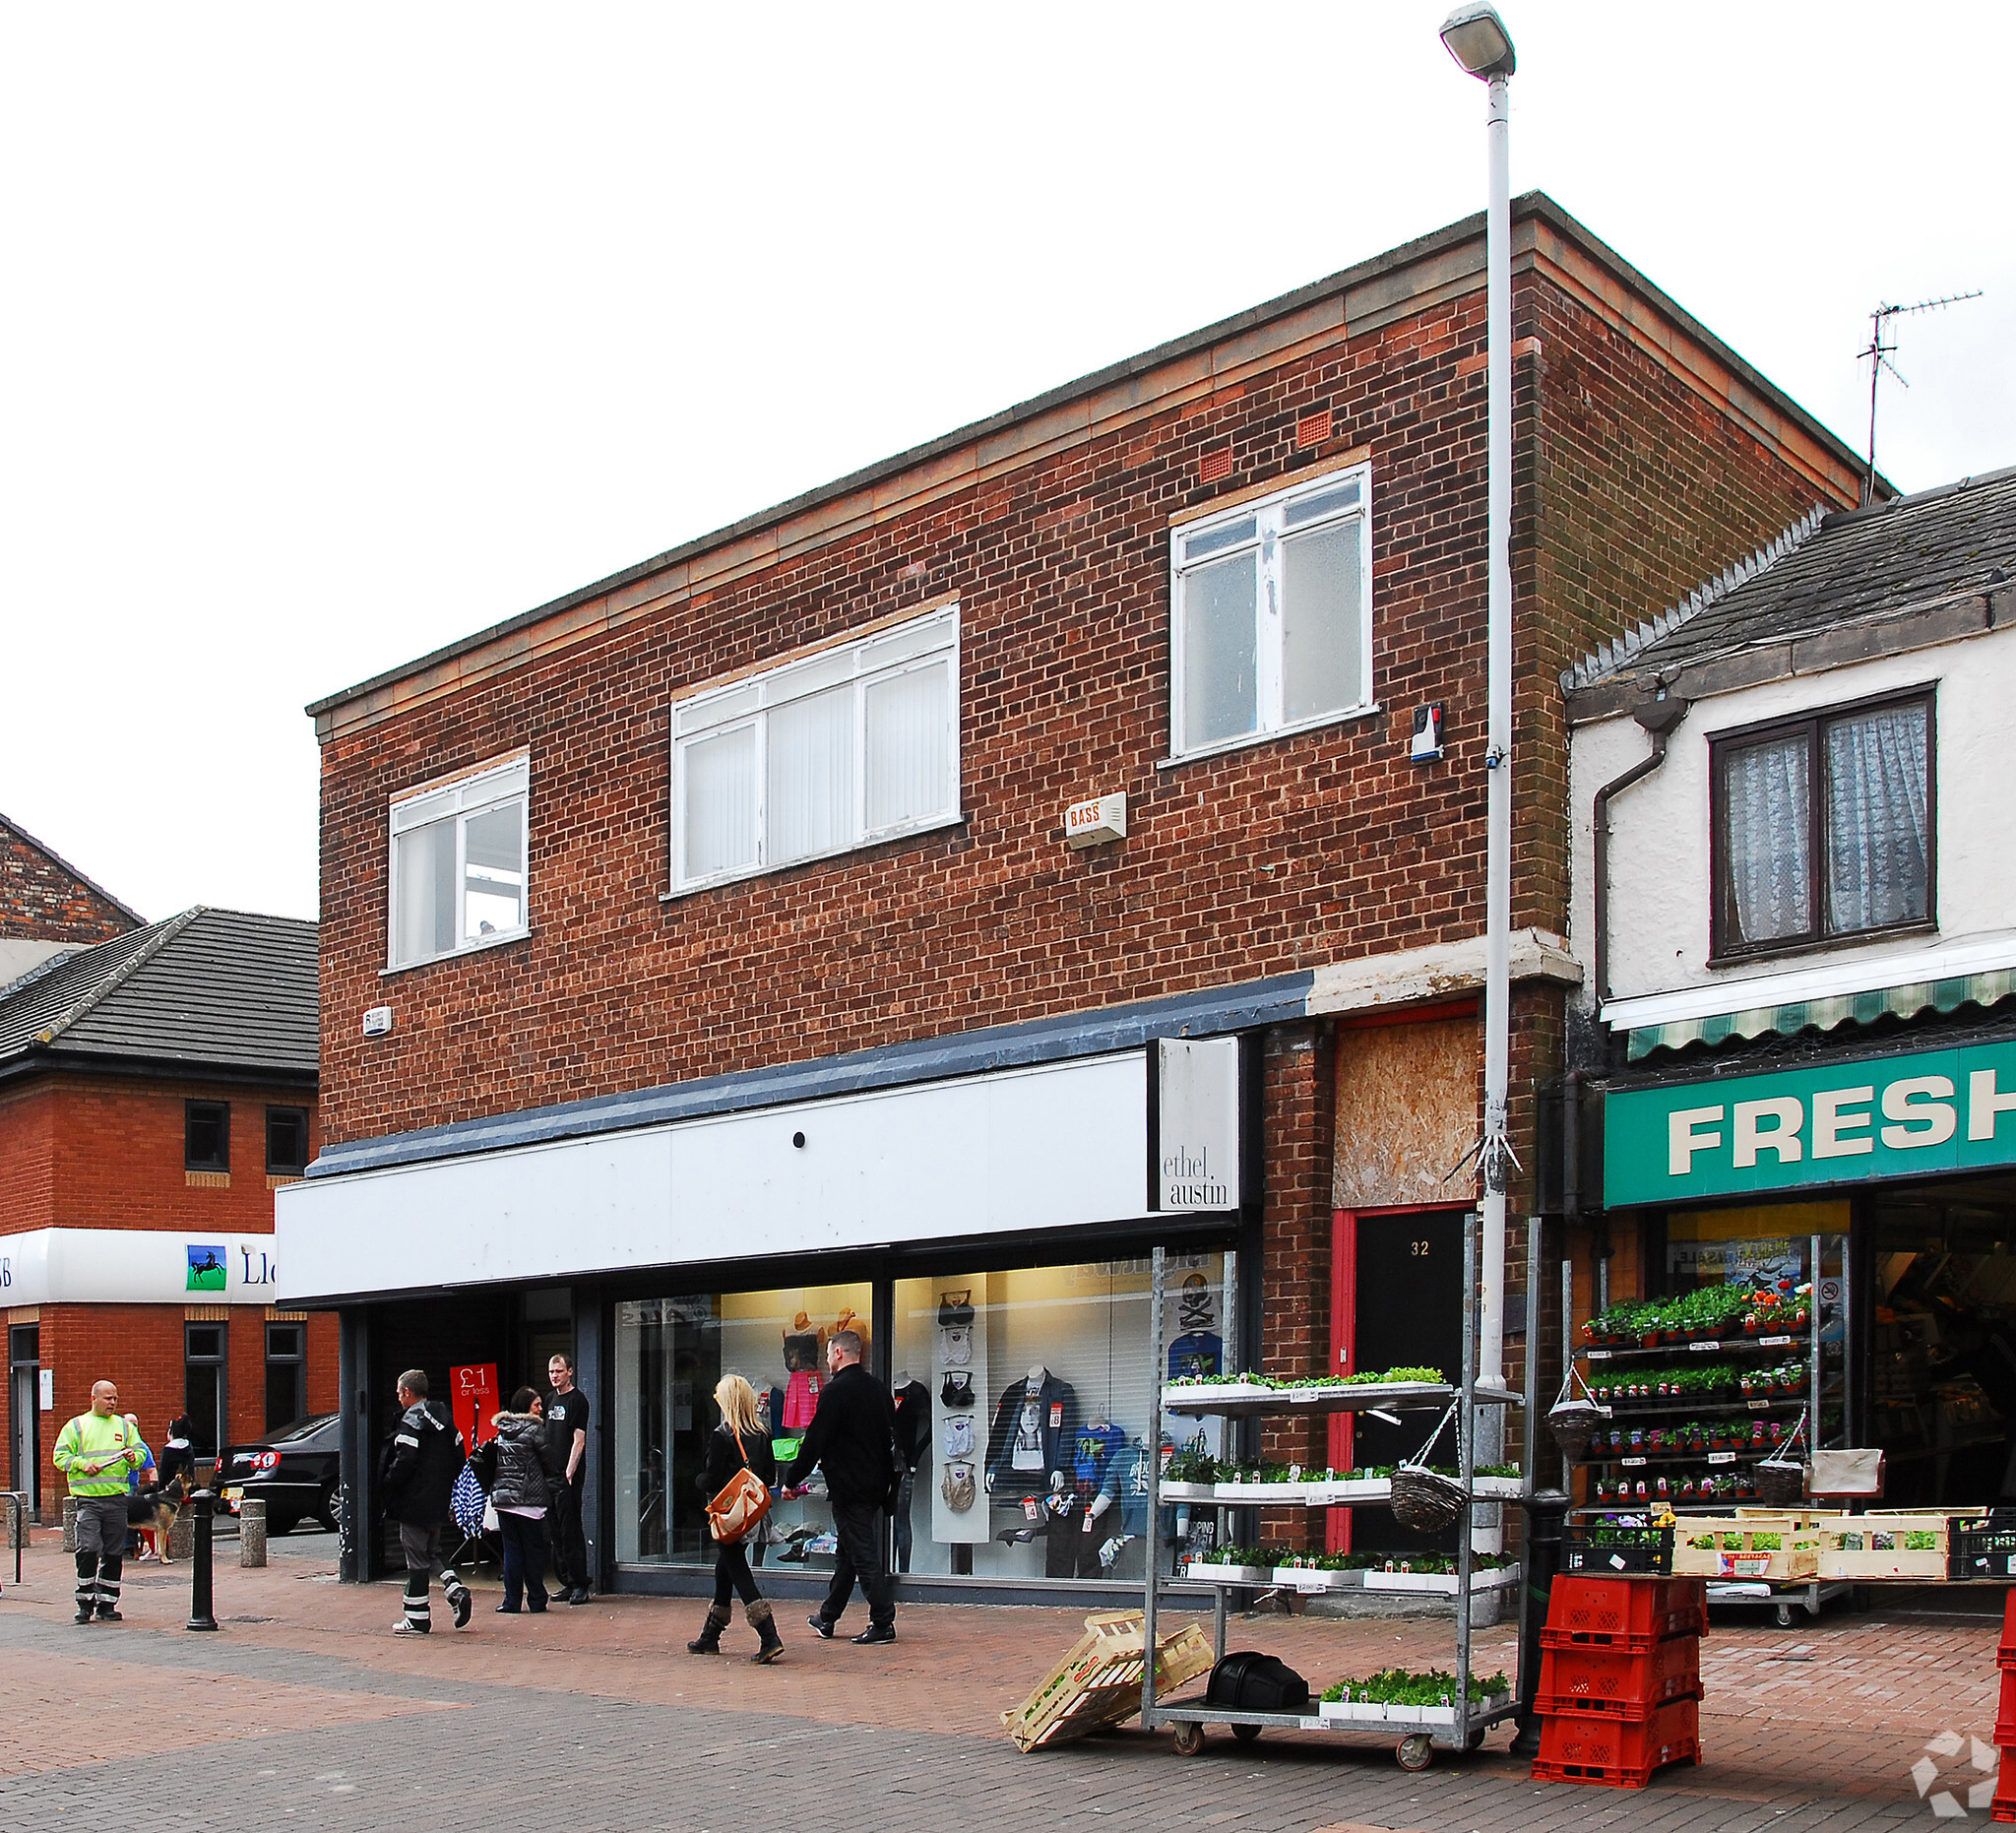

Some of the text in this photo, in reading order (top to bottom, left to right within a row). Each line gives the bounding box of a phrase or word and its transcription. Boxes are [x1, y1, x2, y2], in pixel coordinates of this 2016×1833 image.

[1070, 804, 1101, 827] BASS
[1164, 1145, 1207, 1177] ethel
[1169, 1175, 1228, 1205] austin
[1411, 1240, 1429, 1256] 32
[0, 1257, 12, 1288] B
[460, 1367, 485, 1388] £1
